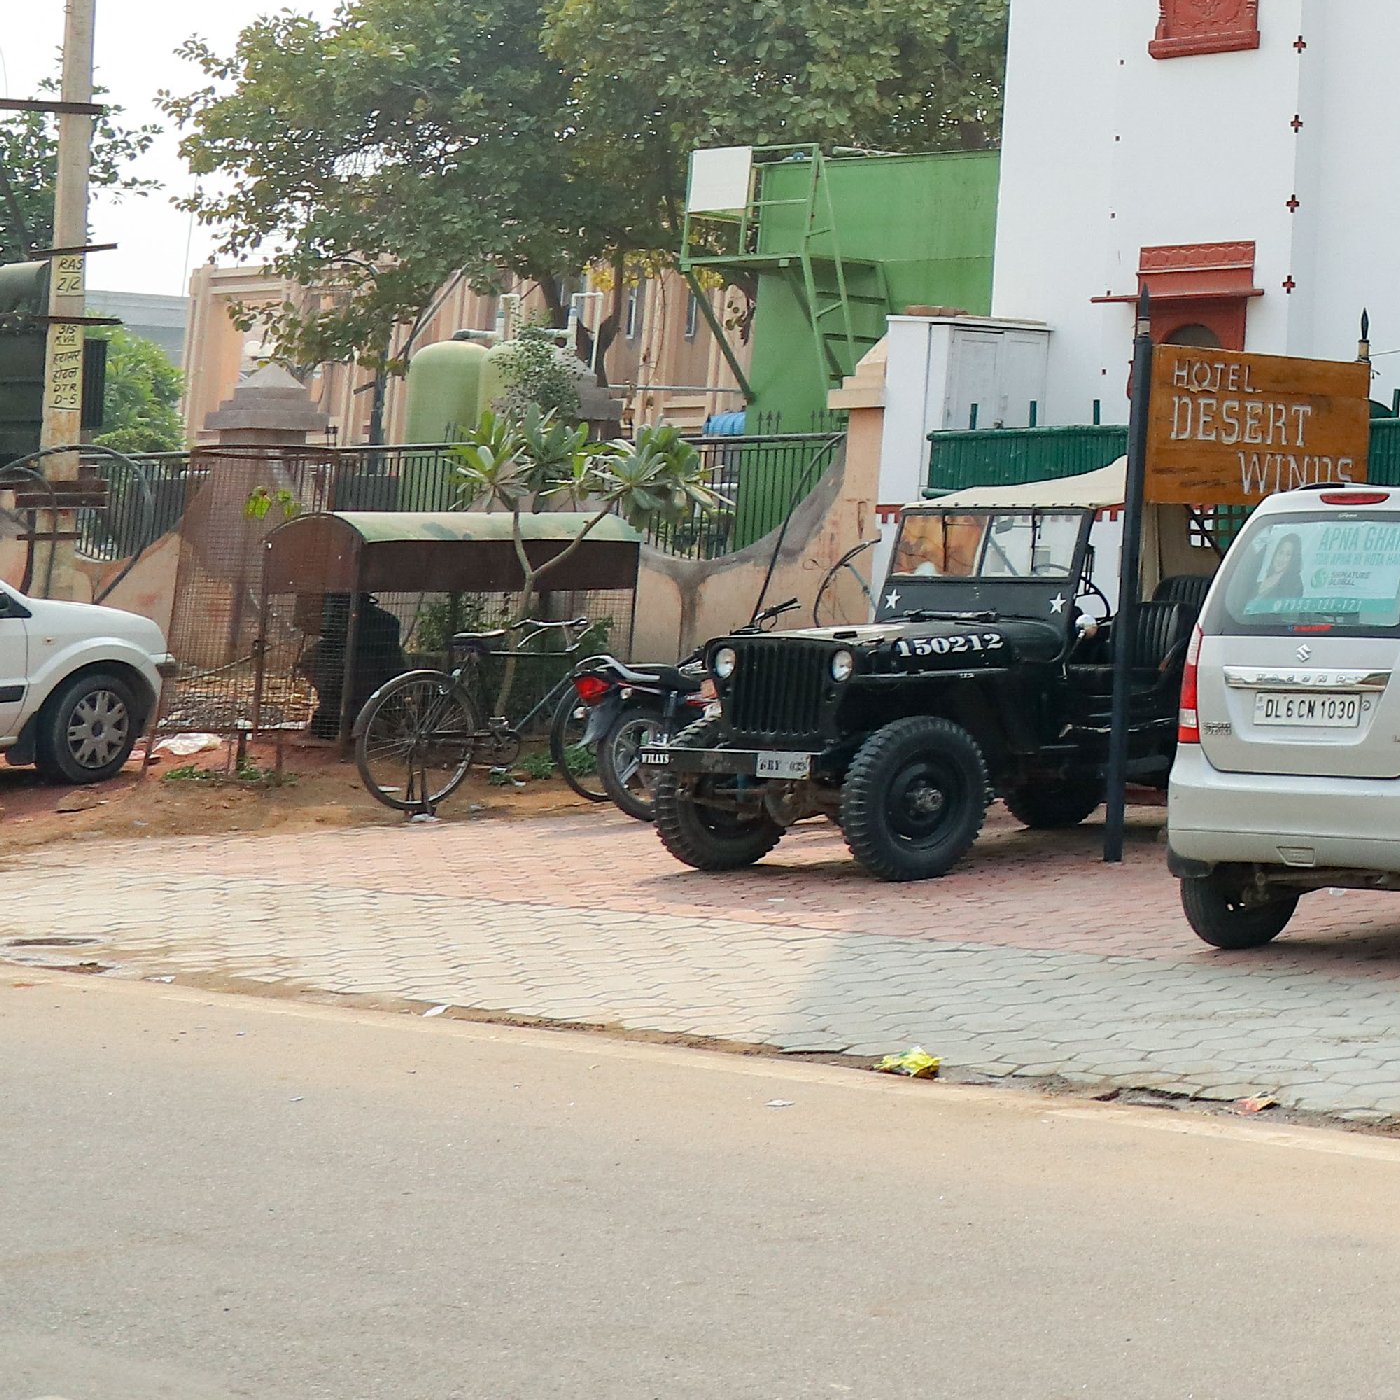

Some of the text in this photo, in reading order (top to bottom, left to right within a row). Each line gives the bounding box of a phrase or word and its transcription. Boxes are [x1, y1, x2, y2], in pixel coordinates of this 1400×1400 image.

[58, 258, 84, 270] RAS
[56, 276, 81, 292] 2/2
[1173, 359, 1258, 392] HOTEL
[1169, 395, 1312, 447] DESERT
[1238, 451, 1354, 494] WINDS
[897, 633, 1004, 657] 150212
[641, 753, 670, 764] WILLYS
